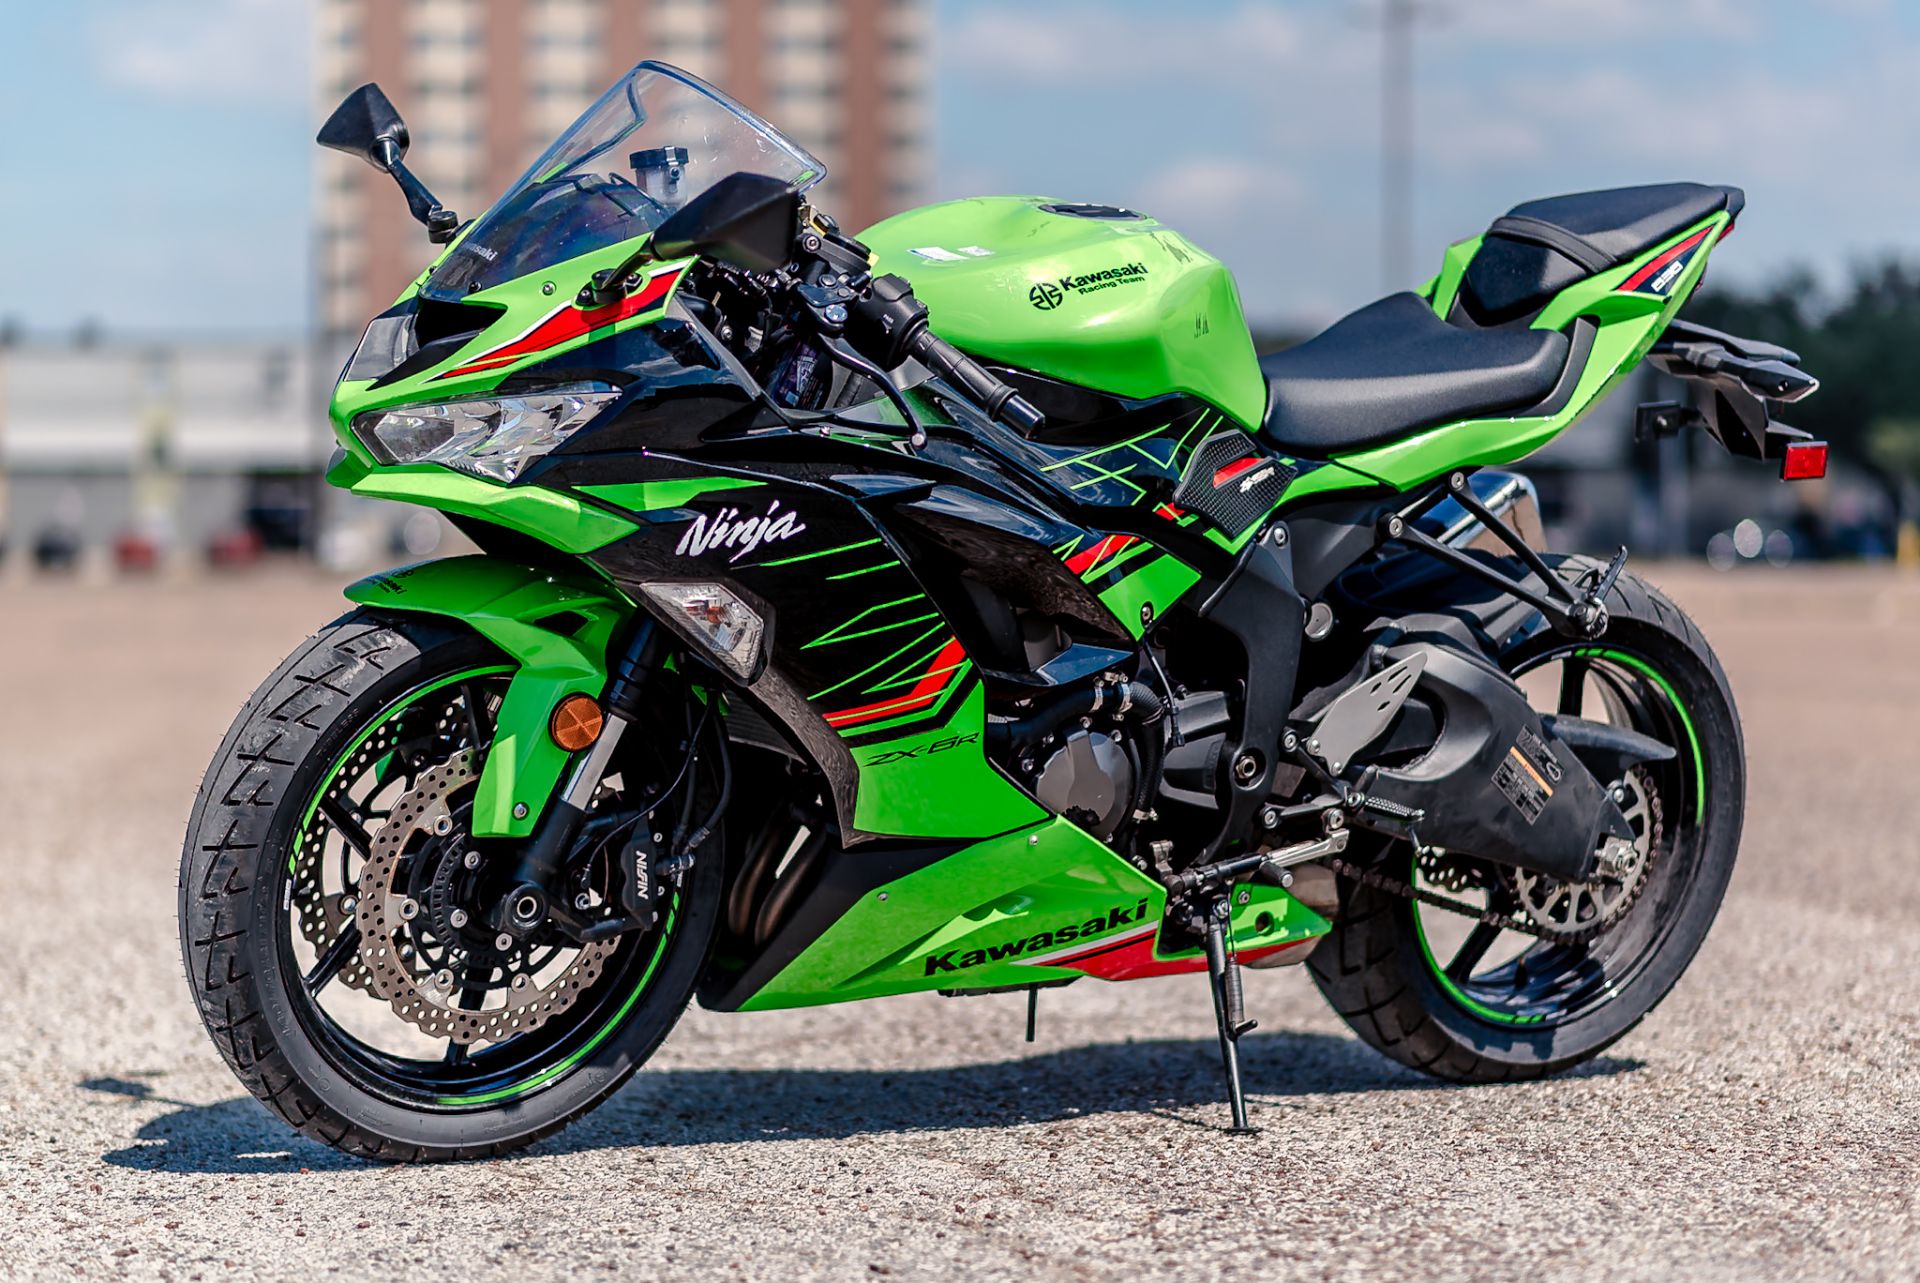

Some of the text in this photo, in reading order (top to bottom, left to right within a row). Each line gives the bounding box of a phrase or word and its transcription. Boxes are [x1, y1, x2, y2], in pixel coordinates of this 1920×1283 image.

[1059, 262, 1149, 291] Kawasaki
[1078, 276, 1146, 295] Racing Team
[675, 499, 806, 563] Ninja
[863, 732, 980, 767] ZX-6R
[635, 850, 649, 900] NISSIN
[924, 898, 1149, 977] Kawasaki
